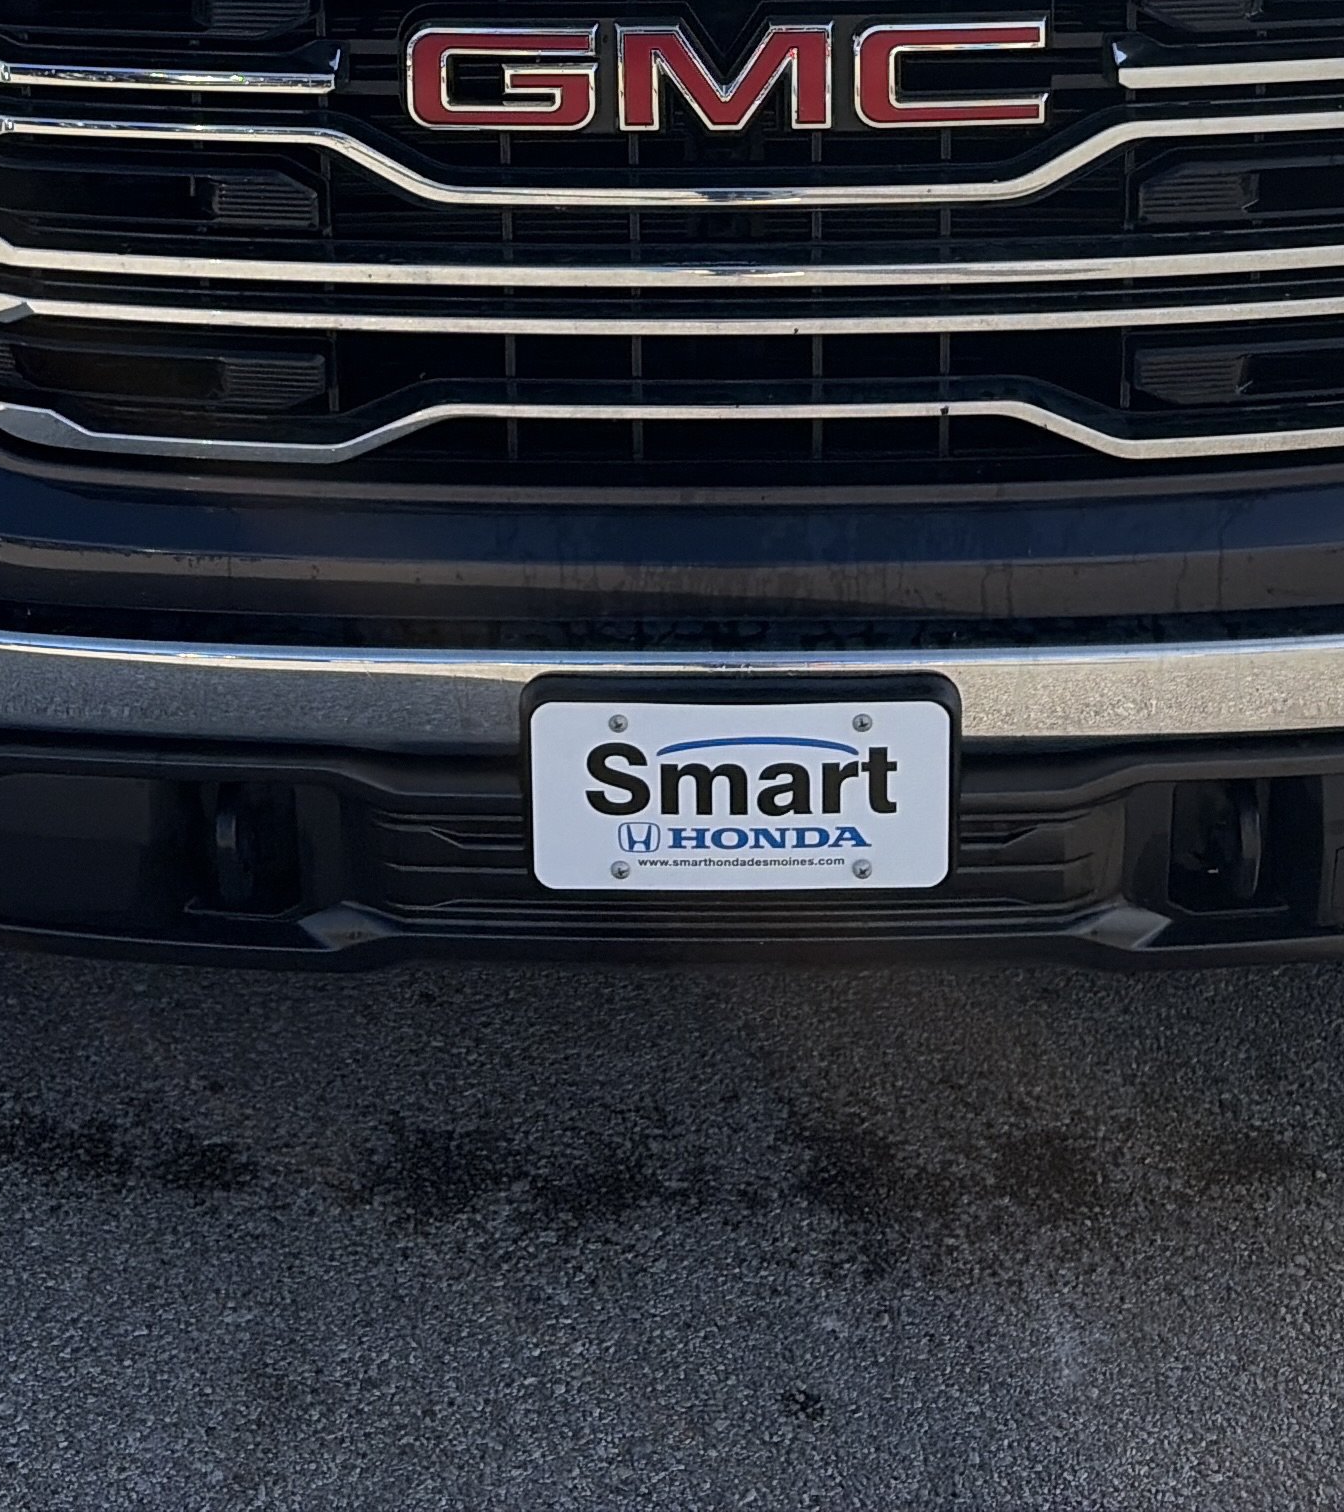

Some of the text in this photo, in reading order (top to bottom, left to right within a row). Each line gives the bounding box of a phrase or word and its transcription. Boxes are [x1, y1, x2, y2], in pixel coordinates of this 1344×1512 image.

[406, 21, 1048, 131] GMC
[585, 742, 898, 816] Smart
[667, 826, 872, 849] HONDA
[637, 856, 846, 868] www.smarthondadesmoines.com
